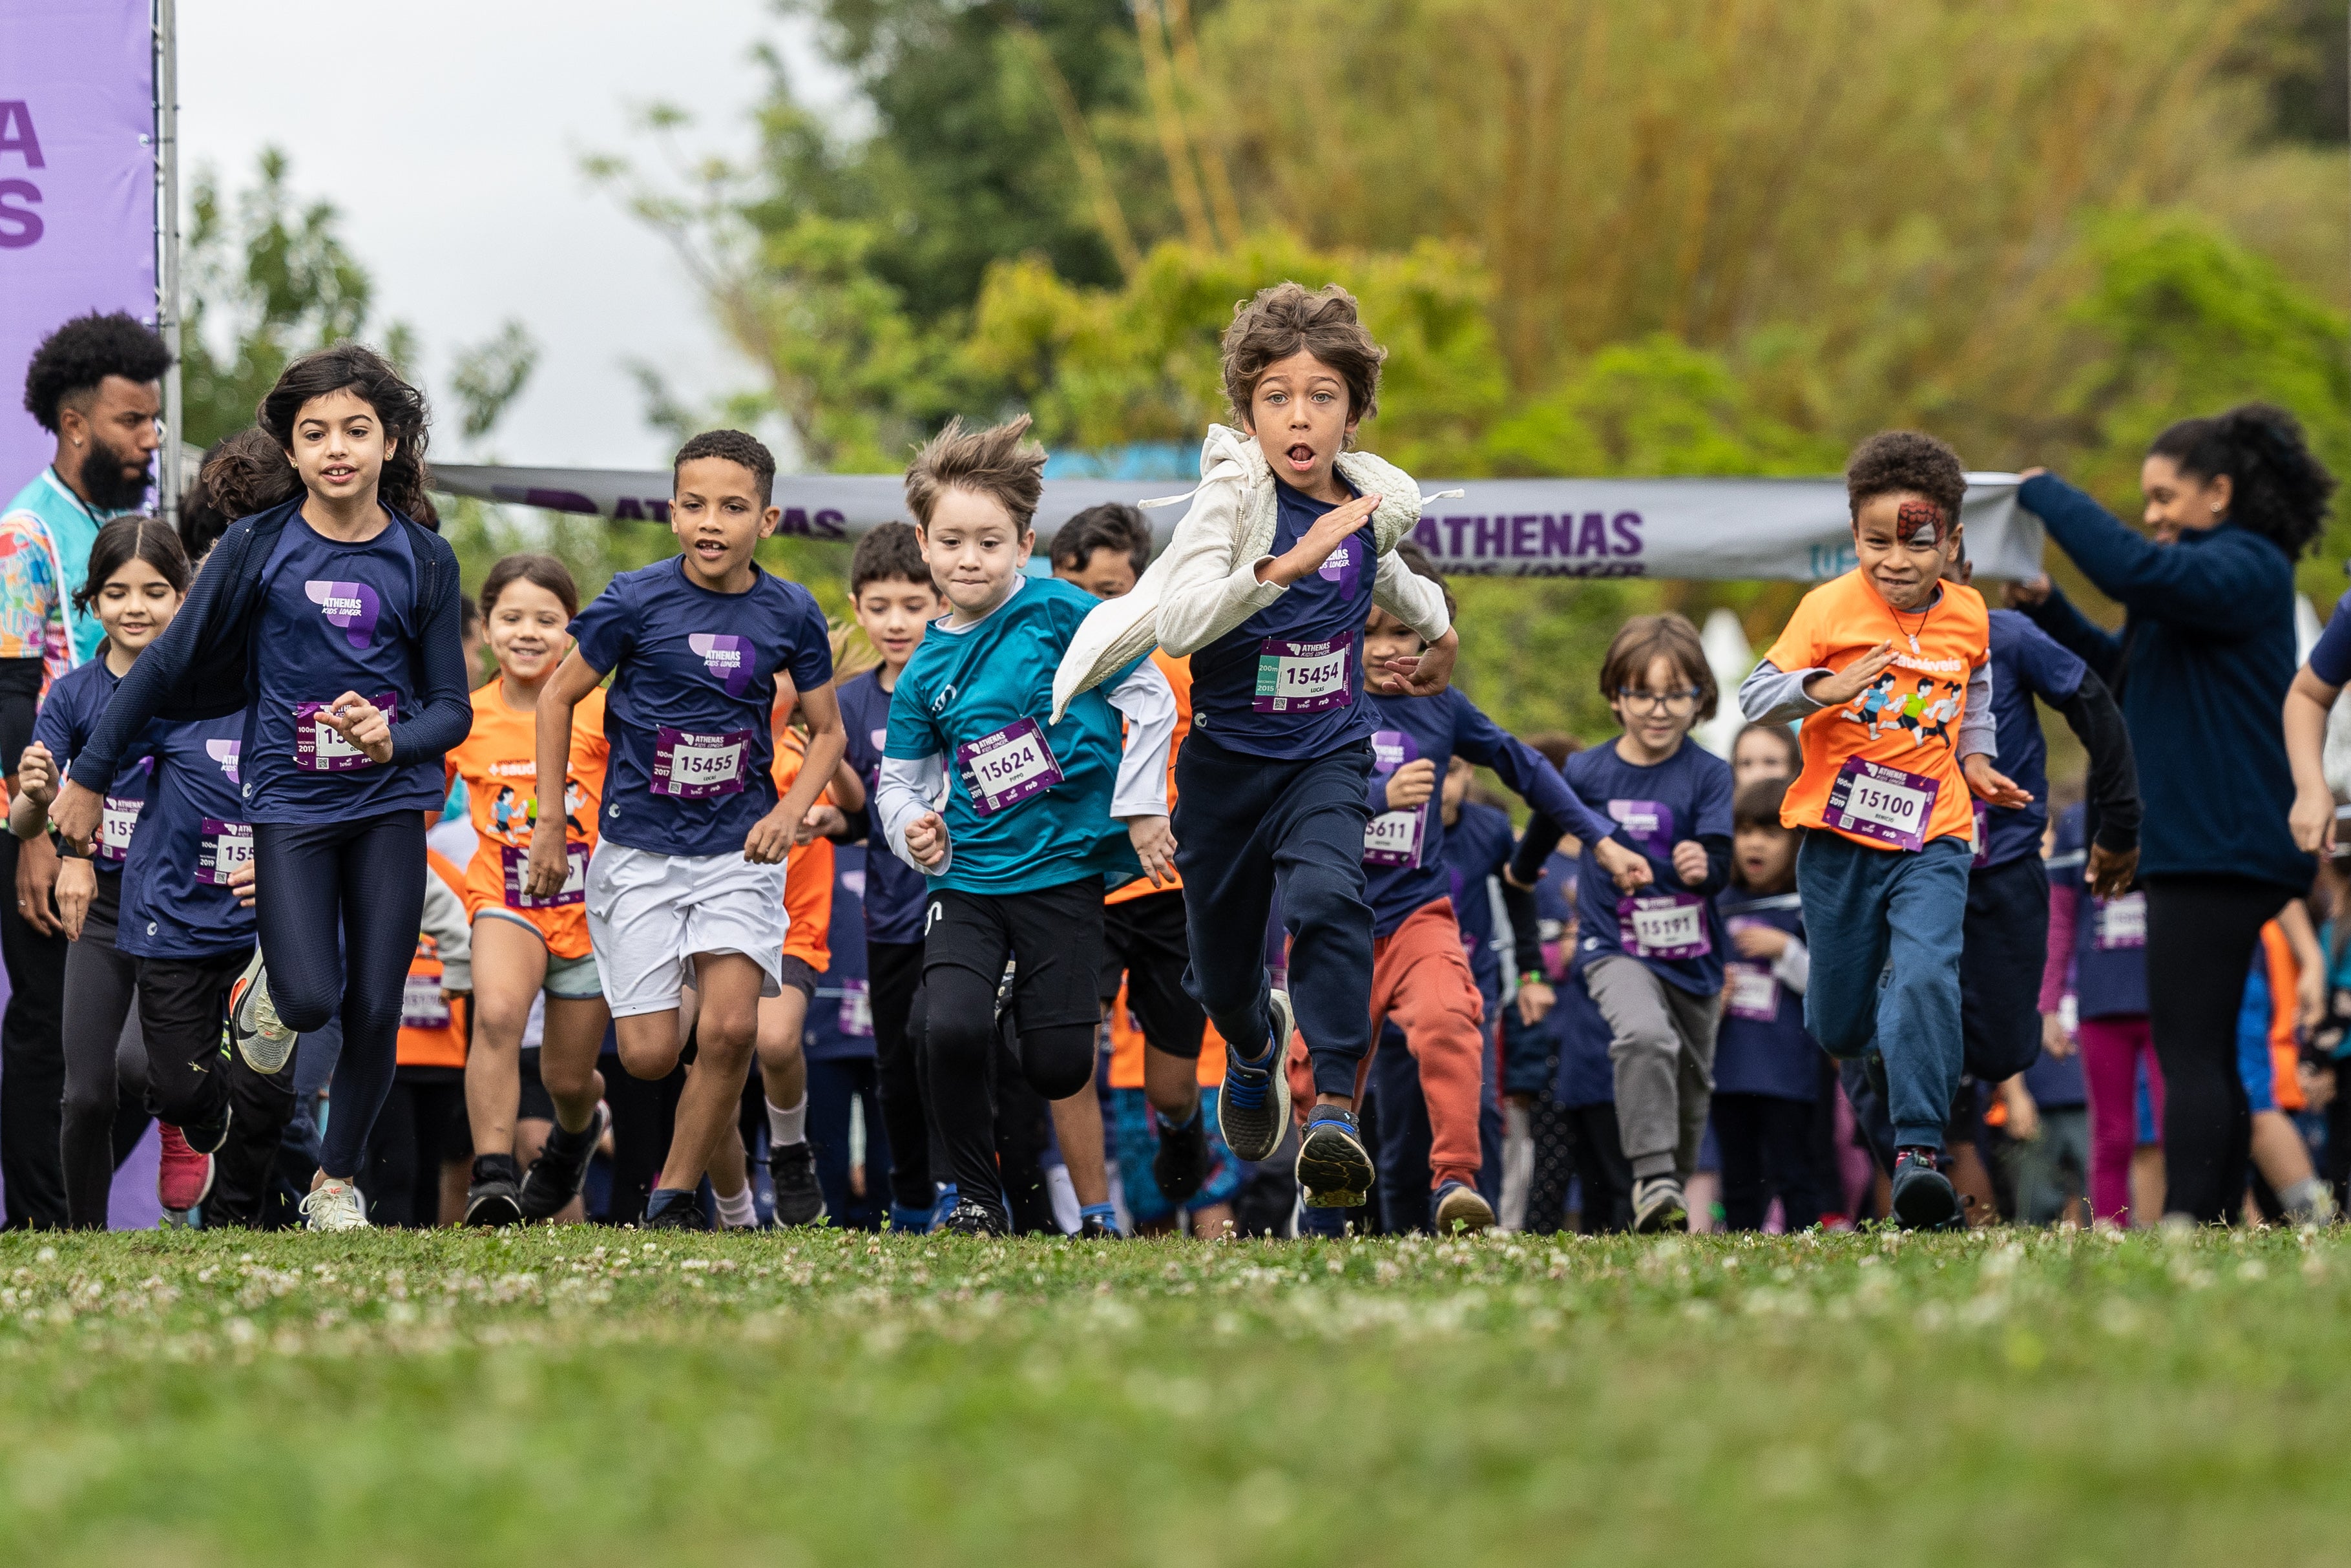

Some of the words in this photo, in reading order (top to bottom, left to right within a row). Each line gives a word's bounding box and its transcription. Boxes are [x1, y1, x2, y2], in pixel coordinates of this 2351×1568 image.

[1412, 511, 1645, 558] ATHENAS
[322, 597, 362, 609] ATHENAS
[321, 607, 339, 615] KIDS
[339, 608, 362, 617] LONGER
[1302, 642, 1331, 653] ATHENAS
[705, 650, 742, 661] ATHENAS
[1259, 664, 1279, 673] 200m
[1286, 661, 1339, 685] 15454
[695, 735, 725, 744] ATHENAS
[978, 731, 1007, 749] ATHENAS
[657, 750, 673, 758] 100m
[681, 754, 733, 773] 15455
[981, 746, 1035, 782] 15624
[654, 768, 671, 777] 2017
[1009, 772, 1024, 782] PIPPO
[1877, 767, 1908, 782] ATHENAS
[1837, 777, 1853, 789] 100m
[970, 788, 982, 799] 2019
[1830, 796, 1846, 808] 2019
[1860, 788, 1914, 818] 15100
[109, 820, 136, 836] 155
[1366, 820, 1405, 839] 5611
[225, 846, 255, 862] 155
[200, 859, 215, 867] 2019
